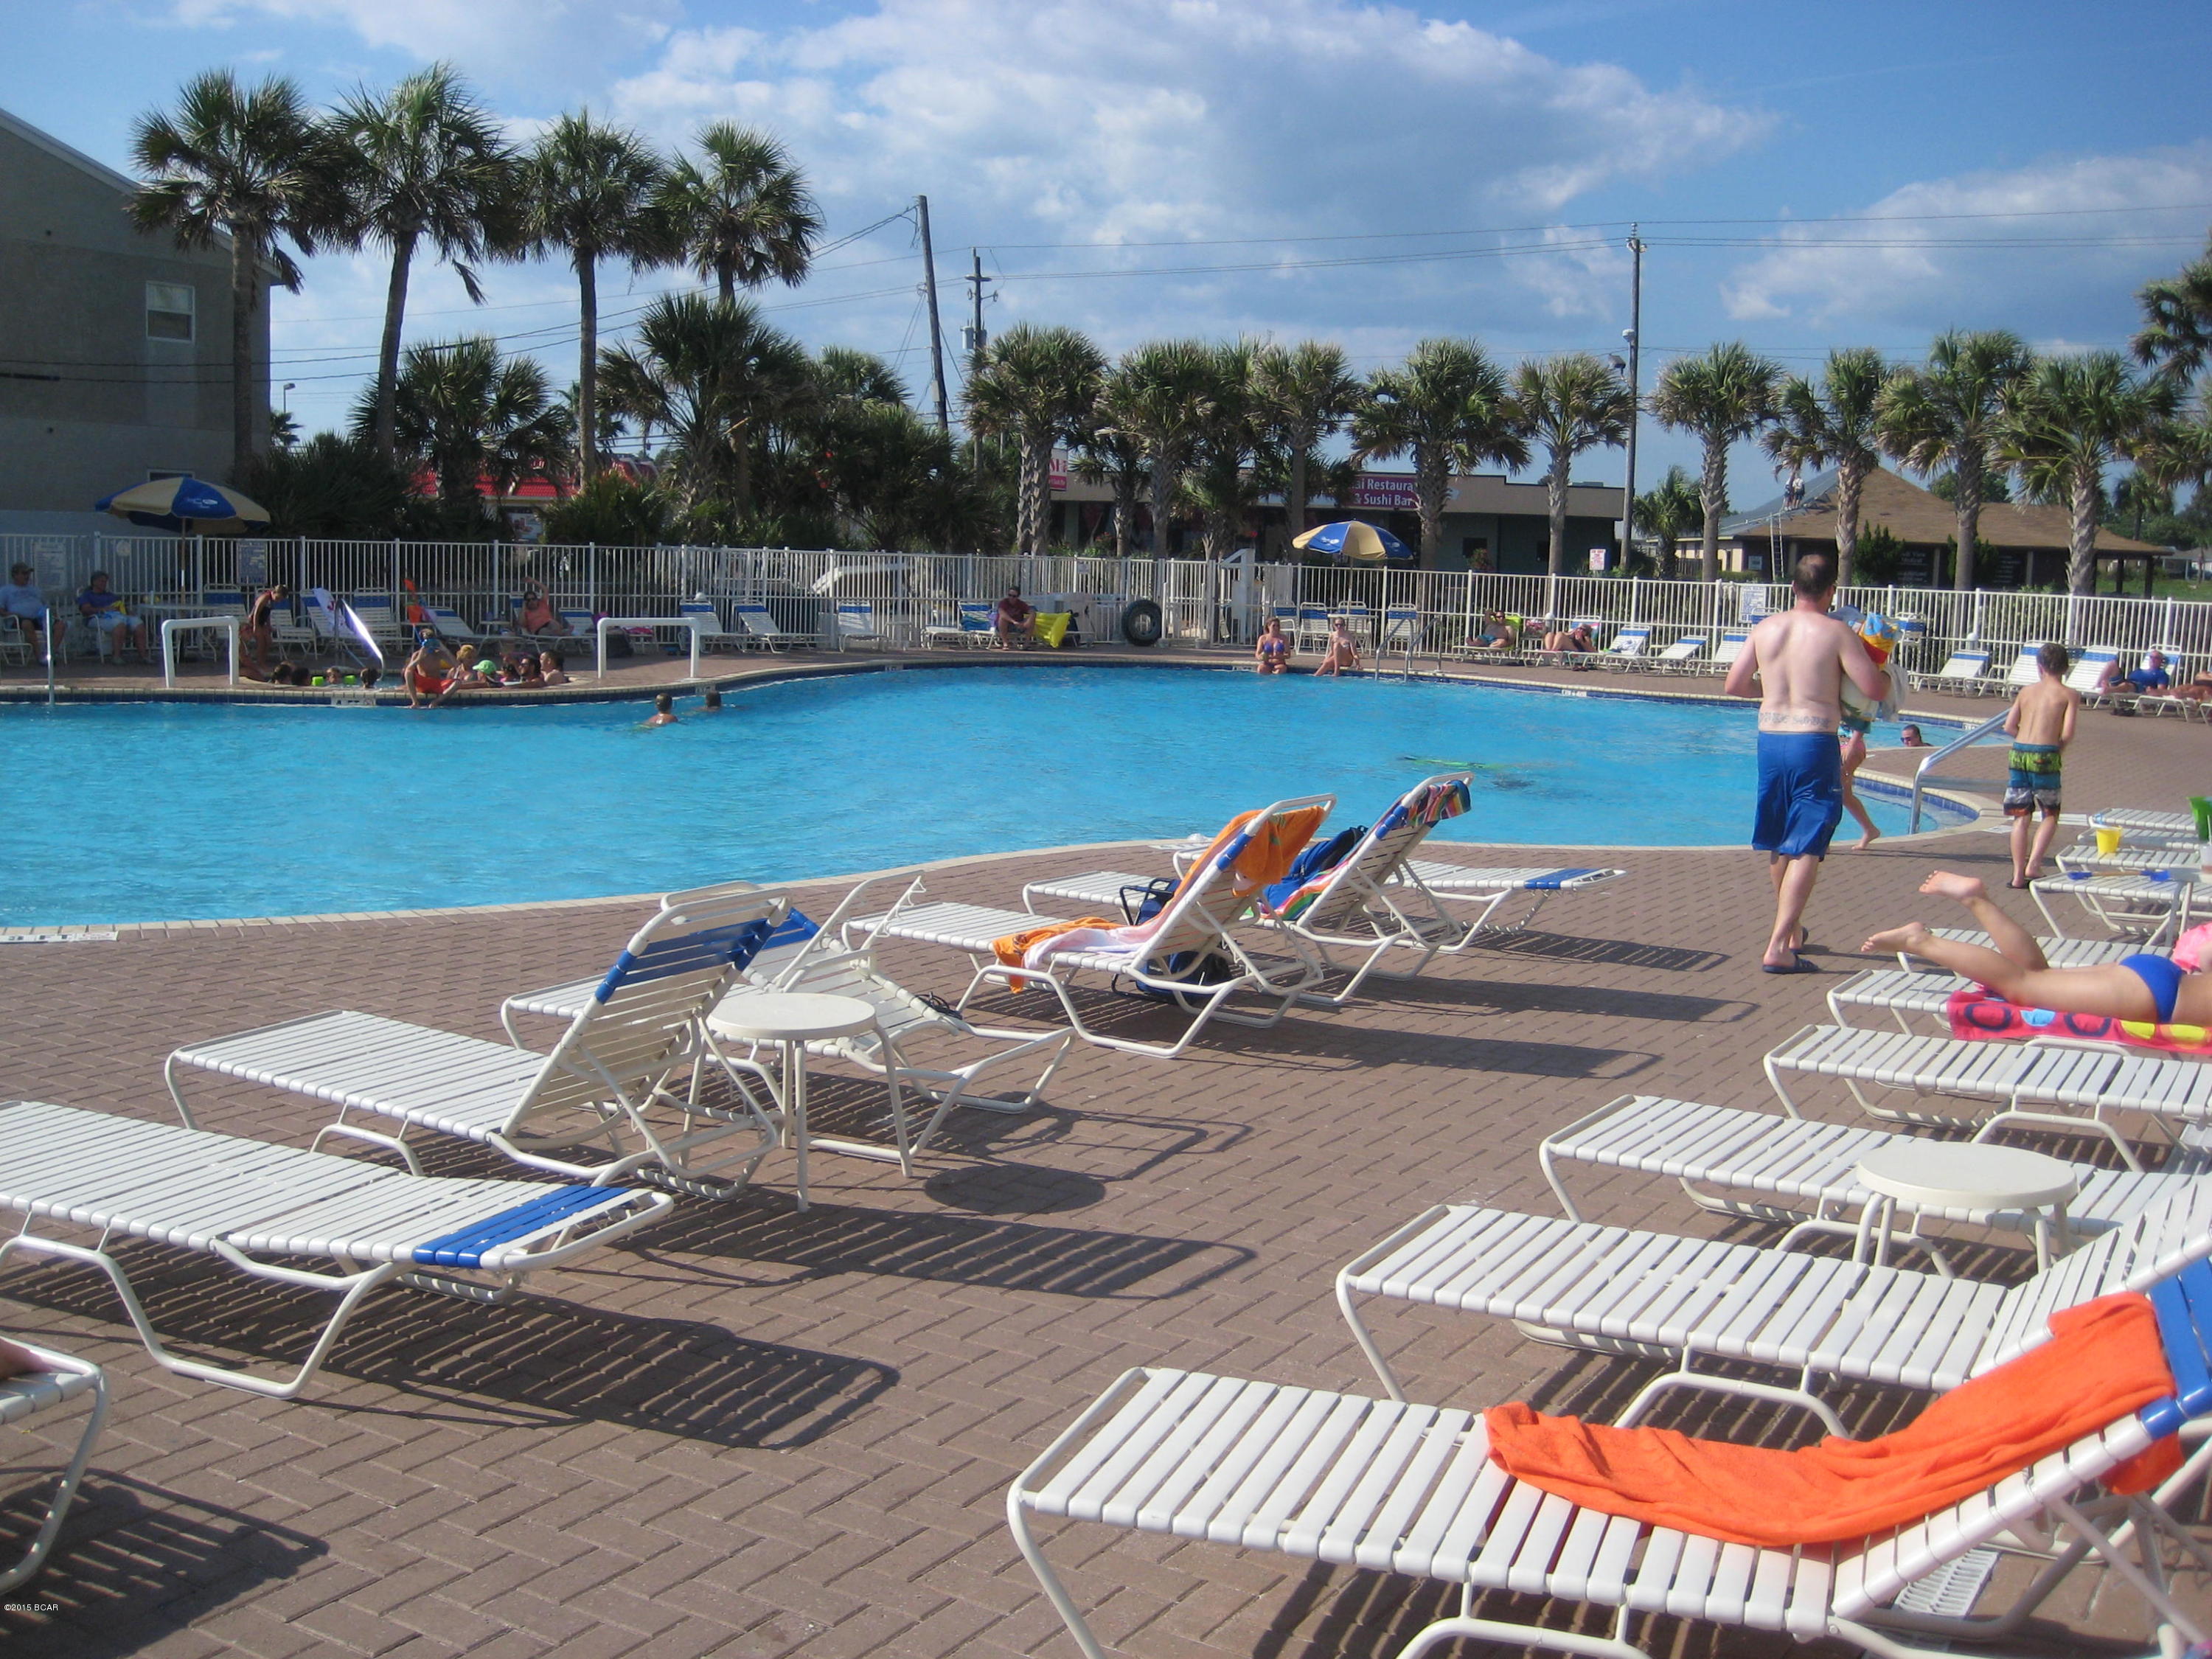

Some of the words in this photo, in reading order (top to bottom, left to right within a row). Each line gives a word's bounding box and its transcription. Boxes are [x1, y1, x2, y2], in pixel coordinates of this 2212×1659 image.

[1352, 479, 1364, 490] ai
[1367, 479, 1414, 491] Restaura
[1354, 493, 1362, 504] &
[1363, 493, 1391, 505] Sushi
[1394, 495, 1412, 506] Bar
